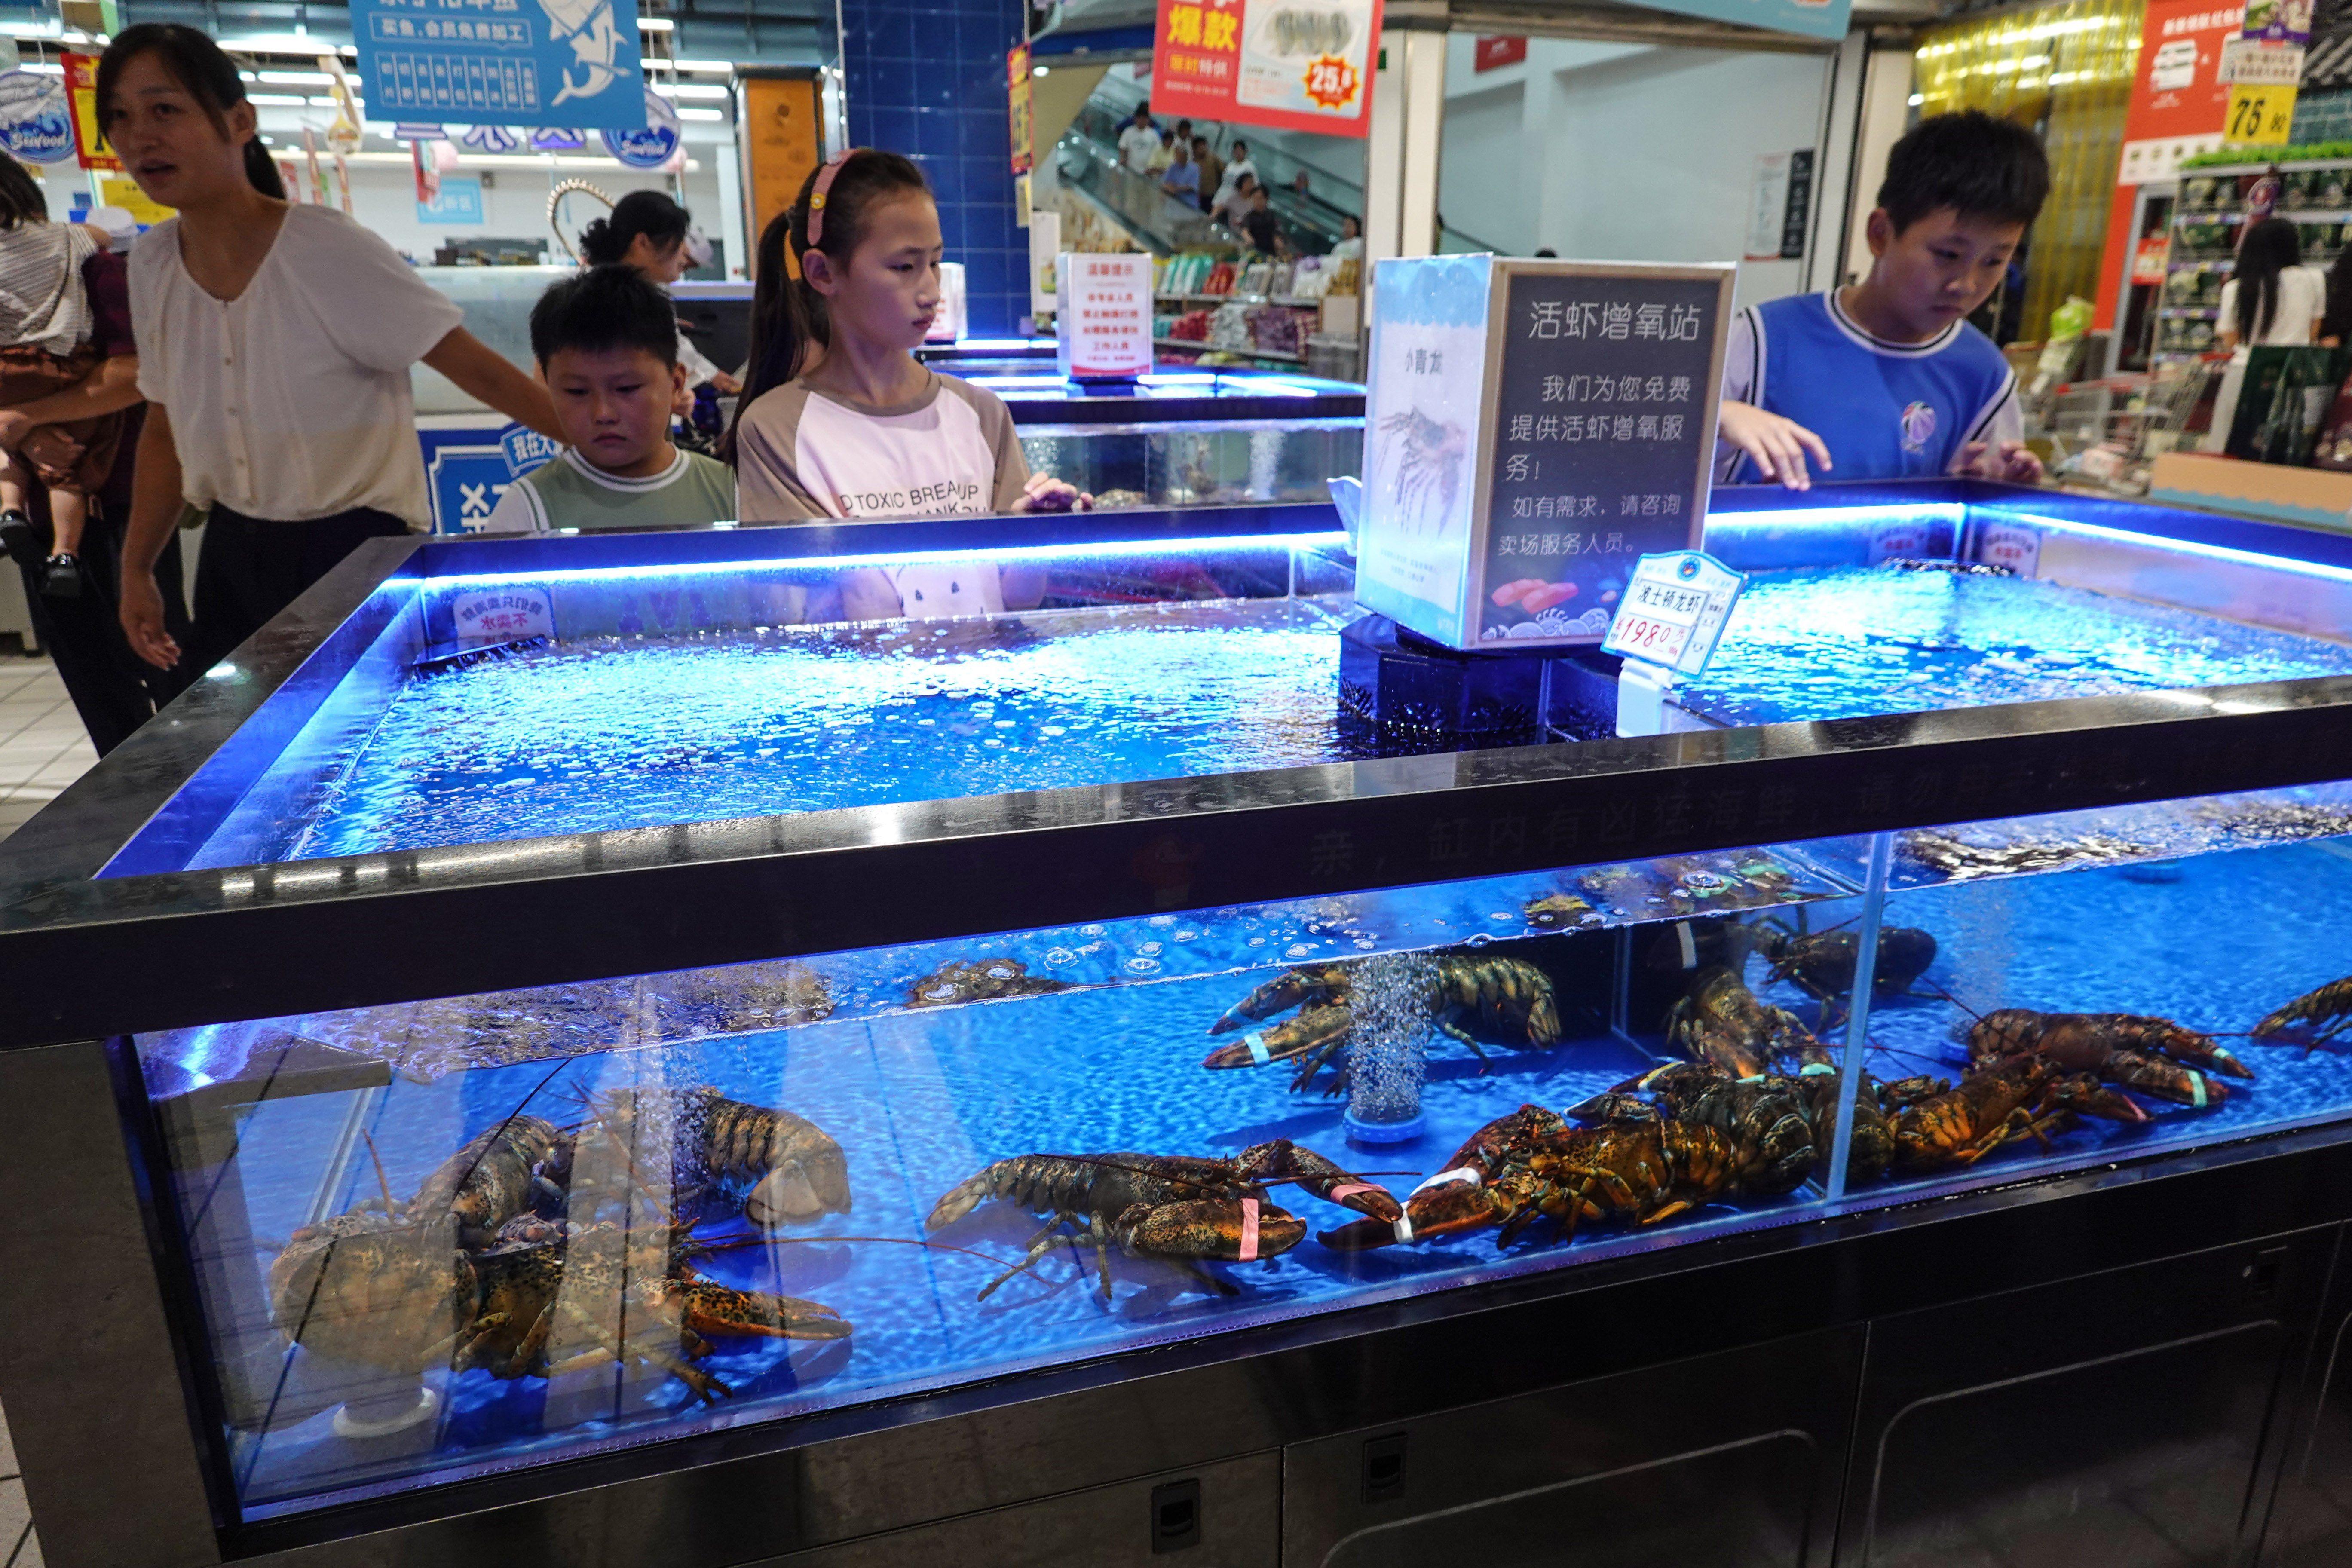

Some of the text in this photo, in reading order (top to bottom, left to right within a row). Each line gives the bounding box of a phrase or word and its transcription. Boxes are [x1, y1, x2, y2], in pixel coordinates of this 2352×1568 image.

[1167, 3, 1237, 52] 爆款
[11, 132, 67, 150] Seafood
[1529, 300, 1701, 341] 活虾增氧站
[1542, 374, 1692, 402] 我们为您免费
[1509, 414, 1684, 441] 提供活虾增氧服
[1512, 494, 1681, 518] 如有需求，请咨询
[1498, 533, 1633, 556] 卖场服务人员。
[1637, 584, 1702, 614] 波士顿龙虾
